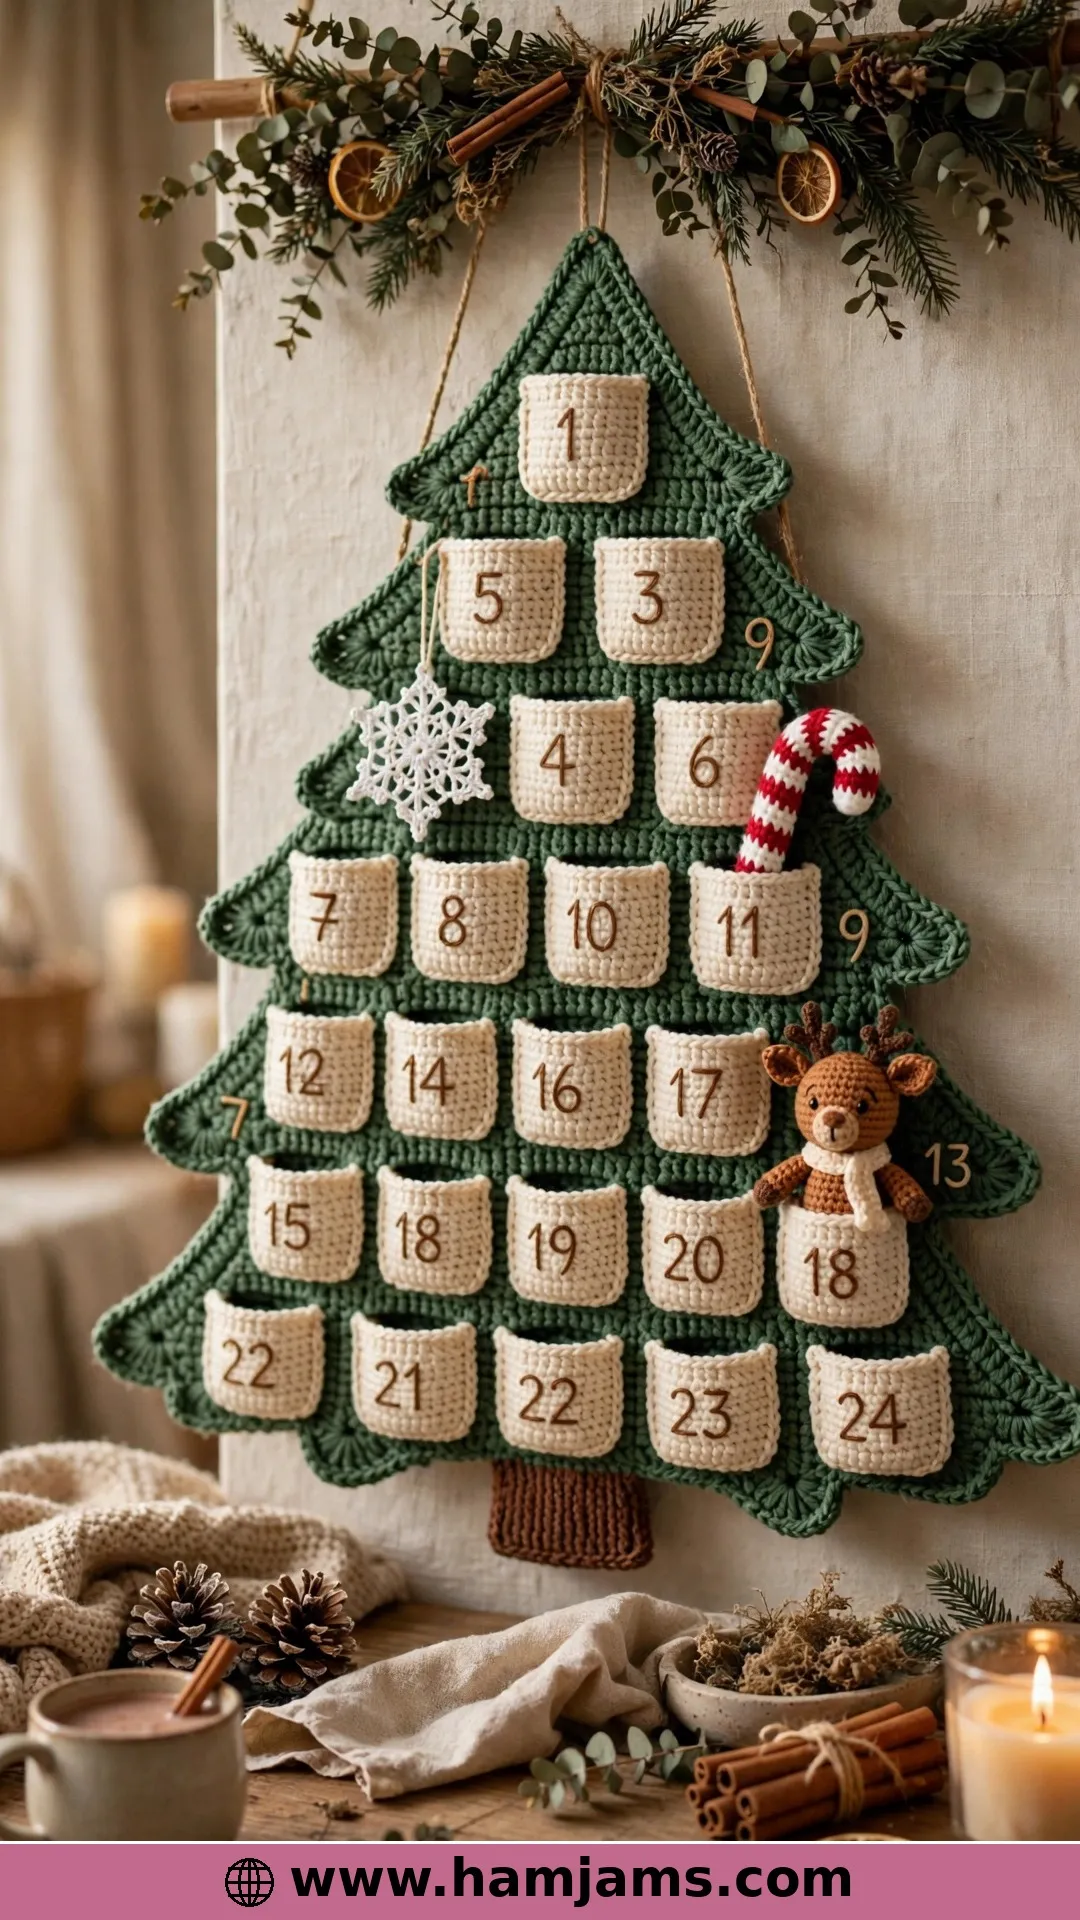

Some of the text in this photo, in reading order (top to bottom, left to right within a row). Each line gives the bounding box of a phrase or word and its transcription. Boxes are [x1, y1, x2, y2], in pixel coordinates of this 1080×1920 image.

[557, 407, 575, 462] 1
[473, 572, 503, 625] 5
[631, 571, 663, 625] 3
[745, 617, 775, 671] 9
[539, 733, 575, 787] 4
[689, 735, 720, 789] 6
[309, 892, 338, 942] 7
[438, 895, 467, 947] 8
[567, 900, 618, 952] 10
[717, 905, 759, 958] 11
[839, 909, 869, 963] 9
[279, 1045, 326, 1096] 12
[401, 1054, 455, 1106] 14
[532, 1063, 582, 1113] 16
[670, 1067, 723, 1120] 17
[221, 1096, 248, 1139] 7
[925, 1143, 971, 1189] 13
[264, 1202, 310, 1250] 15
[395, 1211, 441, 1263] 18
[527, 1222, 577, 1276] 19
[663, 1232, 724, 1284] 20
[803, 1247, 859, 1299] 18
[222, 1339, 275, 1389] 22
[374, 1361, 422, 1411] 21
[518, 1374, 578, 1425] 22
[670, 1387, 732, 1439] 23
[838, 1391, 907, 1444] 24
